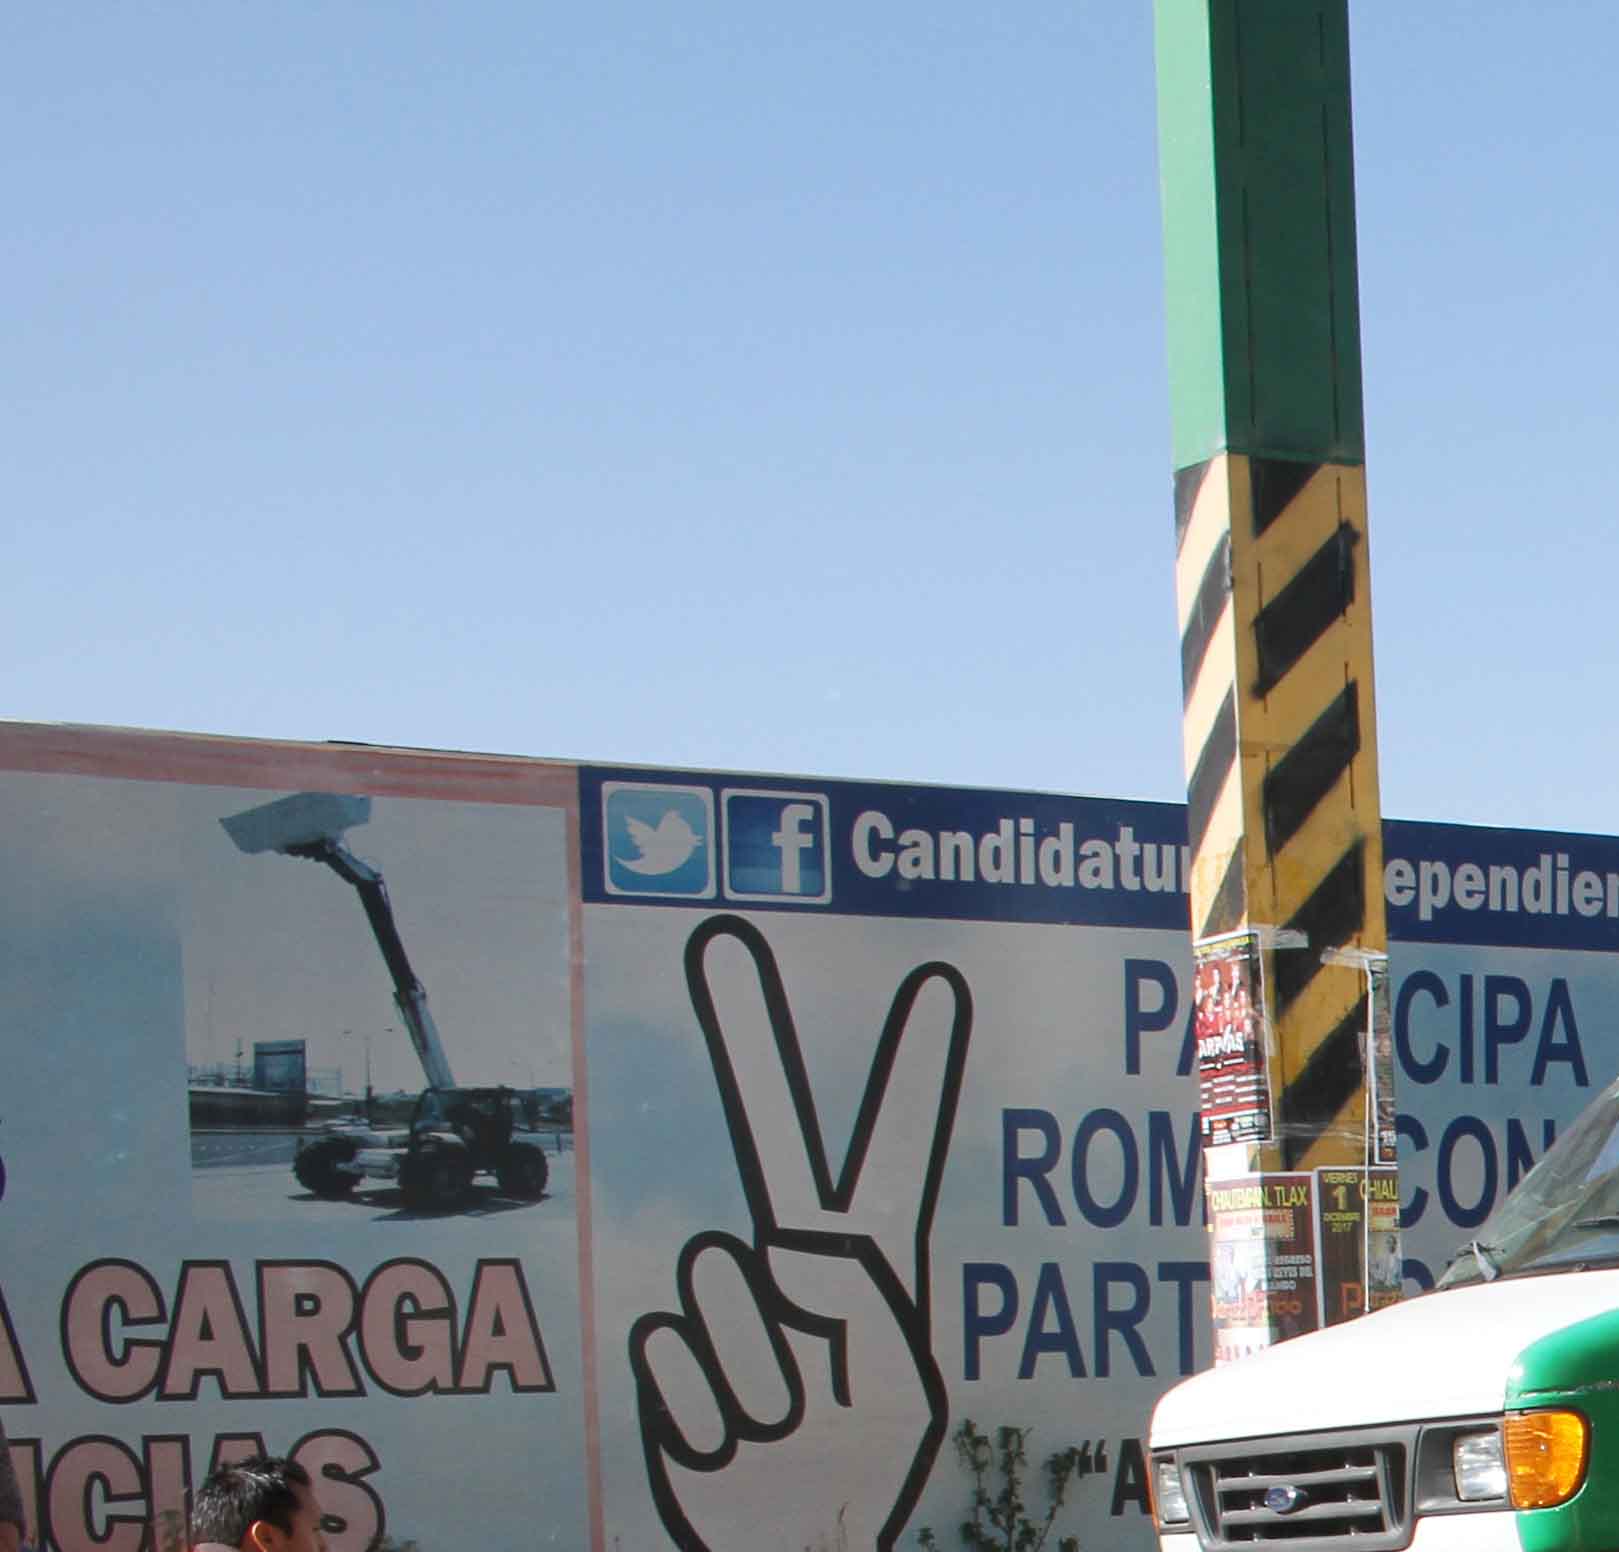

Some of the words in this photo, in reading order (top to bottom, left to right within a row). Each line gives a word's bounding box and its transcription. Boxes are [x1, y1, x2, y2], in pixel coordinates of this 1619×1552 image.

[1002, 1108, 1209, 1229] ROM
[60, 1258, 556, 1404] CARGA
[963, 1262, 1212, 1381] PART
